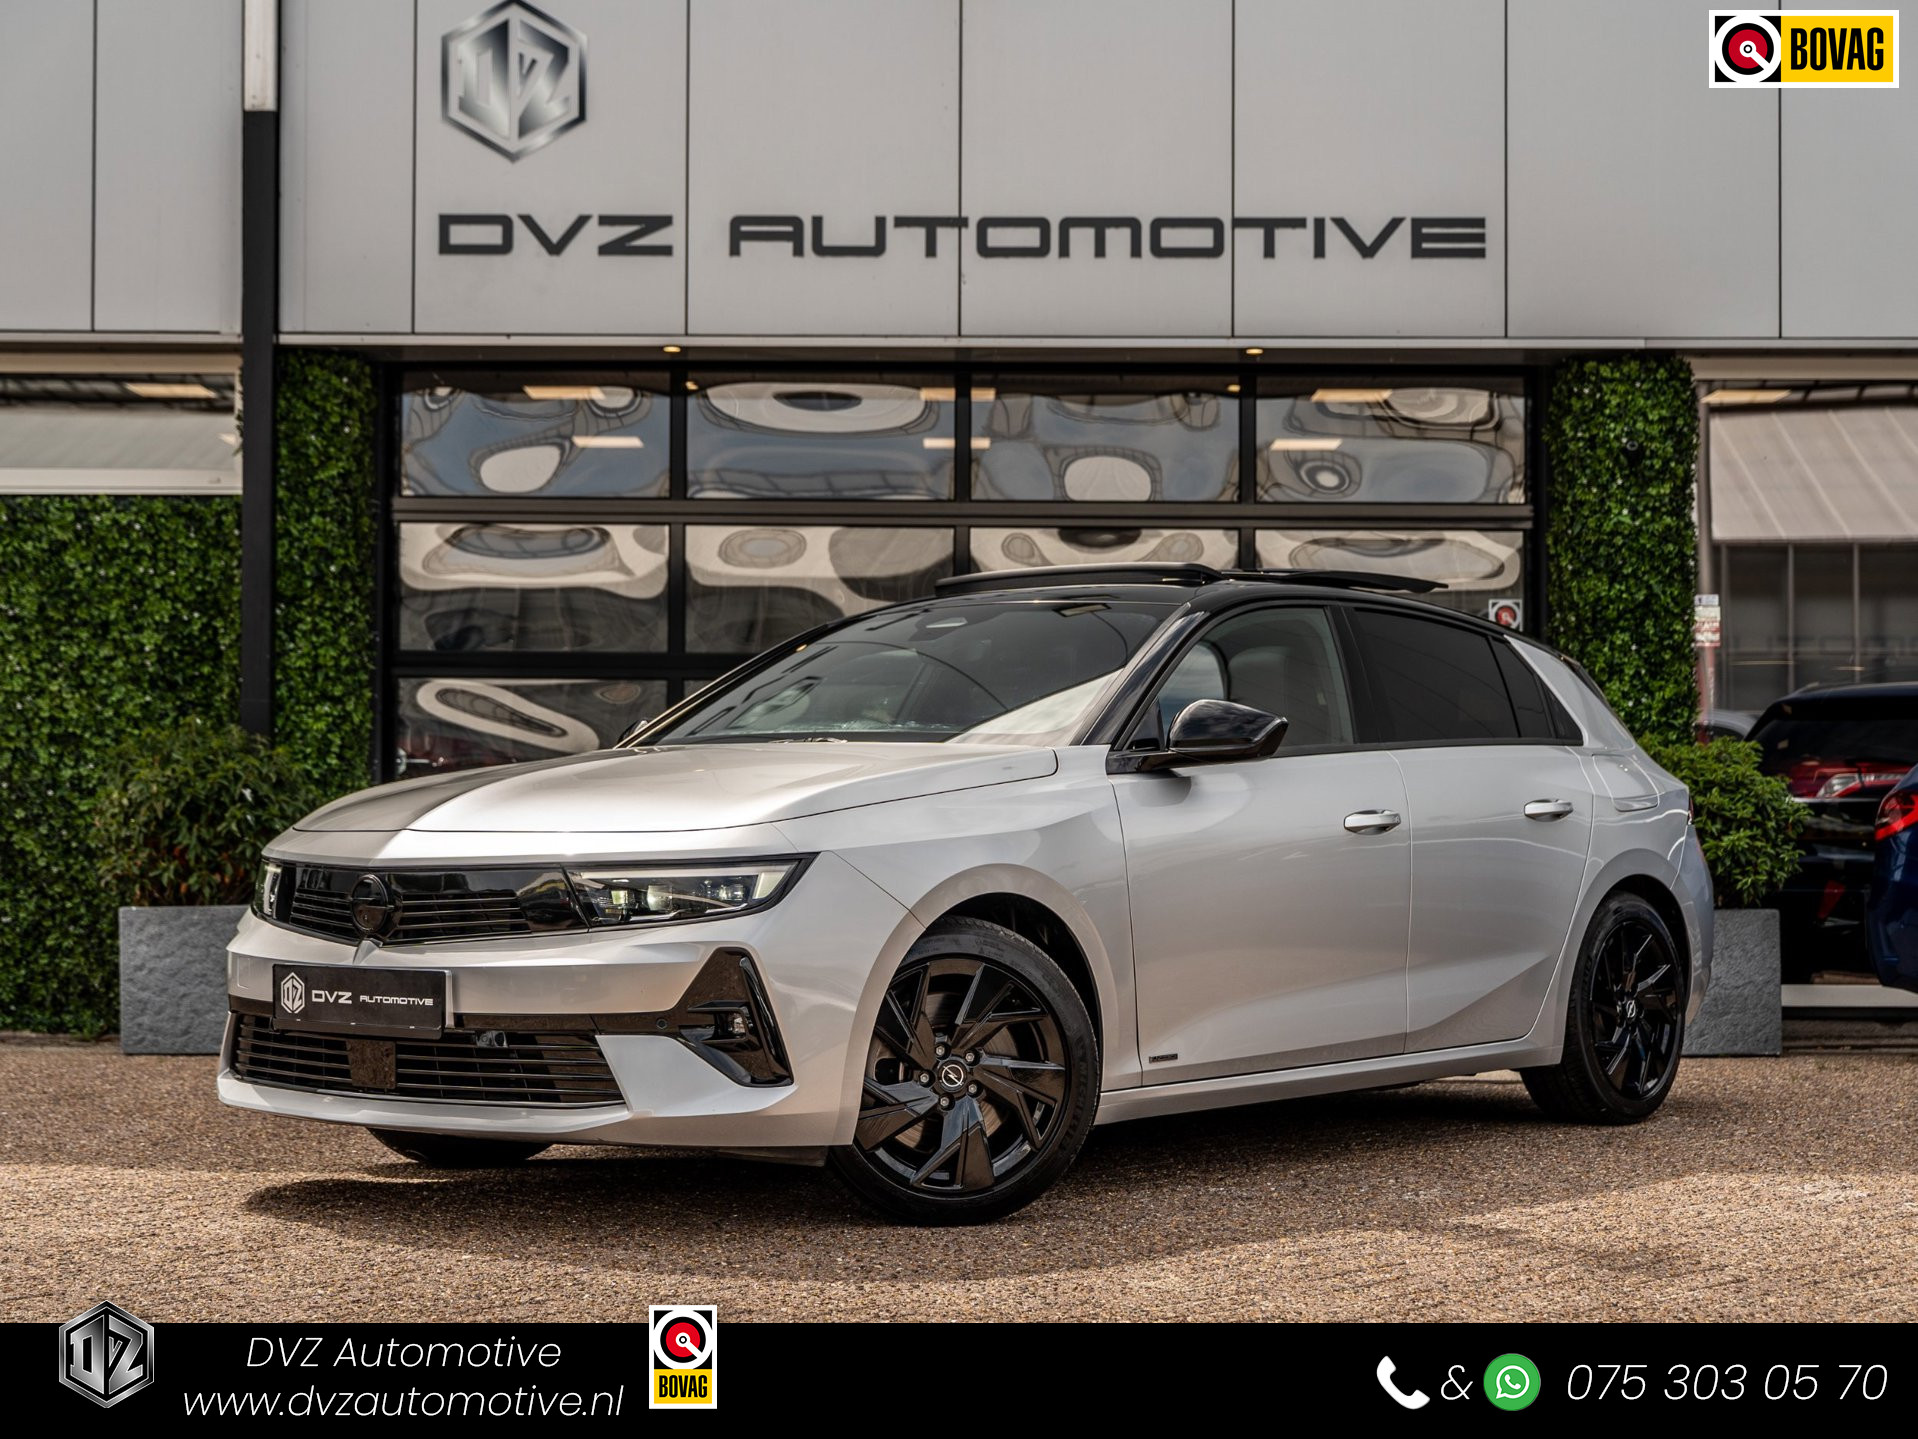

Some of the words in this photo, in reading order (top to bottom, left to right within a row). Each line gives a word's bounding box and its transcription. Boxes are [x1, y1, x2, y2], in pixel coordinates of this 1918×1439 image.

[439, 214, 674, 257] DVZ
[729, 215, 1486, 260] AUTOMOTIVE
[312, 990, 352, 1004] DVZ
[360, 995, 434, 1006] AUTOMOTIVE
